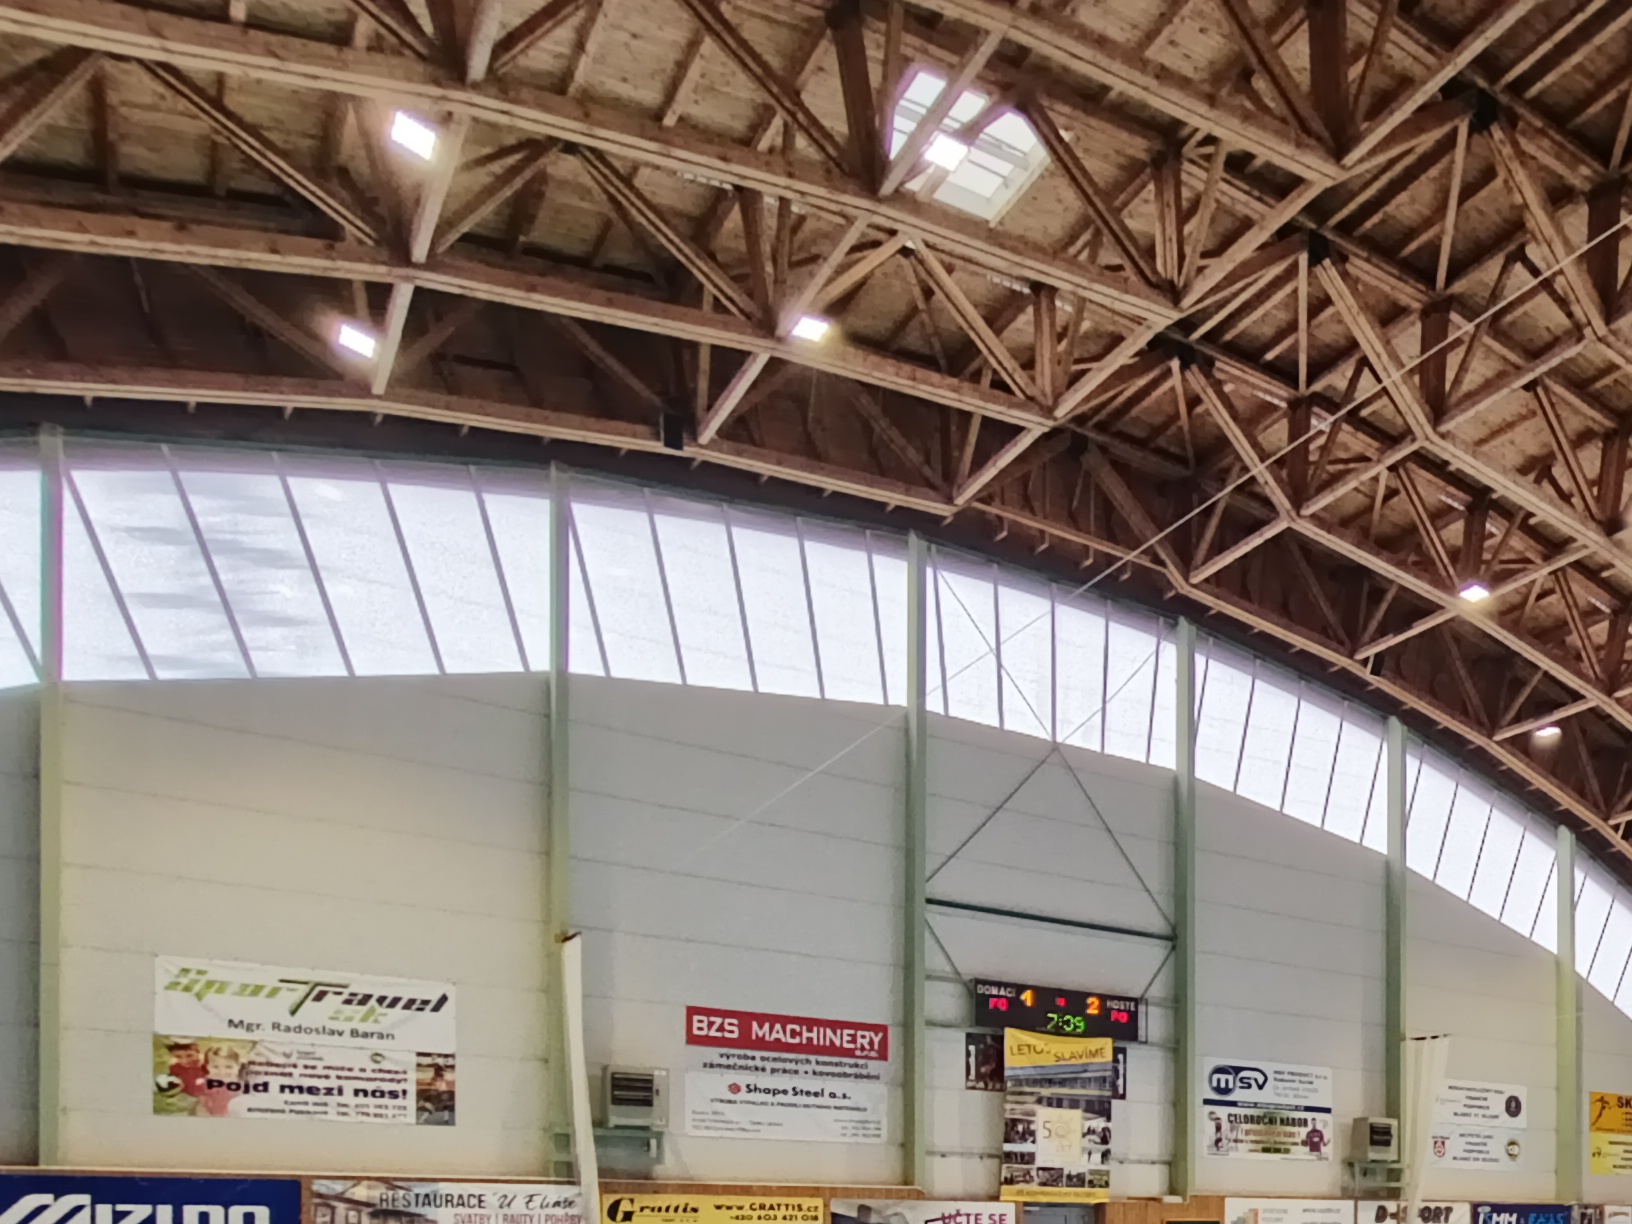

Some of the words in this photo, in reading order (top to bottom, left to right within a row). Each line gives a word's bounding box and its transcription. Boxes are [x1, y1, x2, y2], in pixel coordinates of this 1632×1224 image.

[1020, 989, 1033, 1007] 1
[1086, 996, 1100, 1014] 2
[227, 1018, 264, 1033] Mgr.
[272, 1021, 345, 1038] Radoslav
[350, 1028, 395, 1041] Baran
[1046, 1013, 1086, 1033] 7:39
[692, 1015, 739, 1038] BZS
[752, 1021, 884, 1050] MACHINERY
[279, 1085, 344, 1097] mezi
[353, 1086, 408, 1101] nás!
[745, 1083, 789, 1097] Shape
[792, 1086, 825, 1098] Steel
[828, 1091, 852, 1100] a.s.
[380, 1193, 487, 1209] RESTAURACE
[607, 1197, 699, 1223] Grattis
[453, 1213, 492, 1224] SVATBY
[502, 1213, 535, 1224] RAUTY
